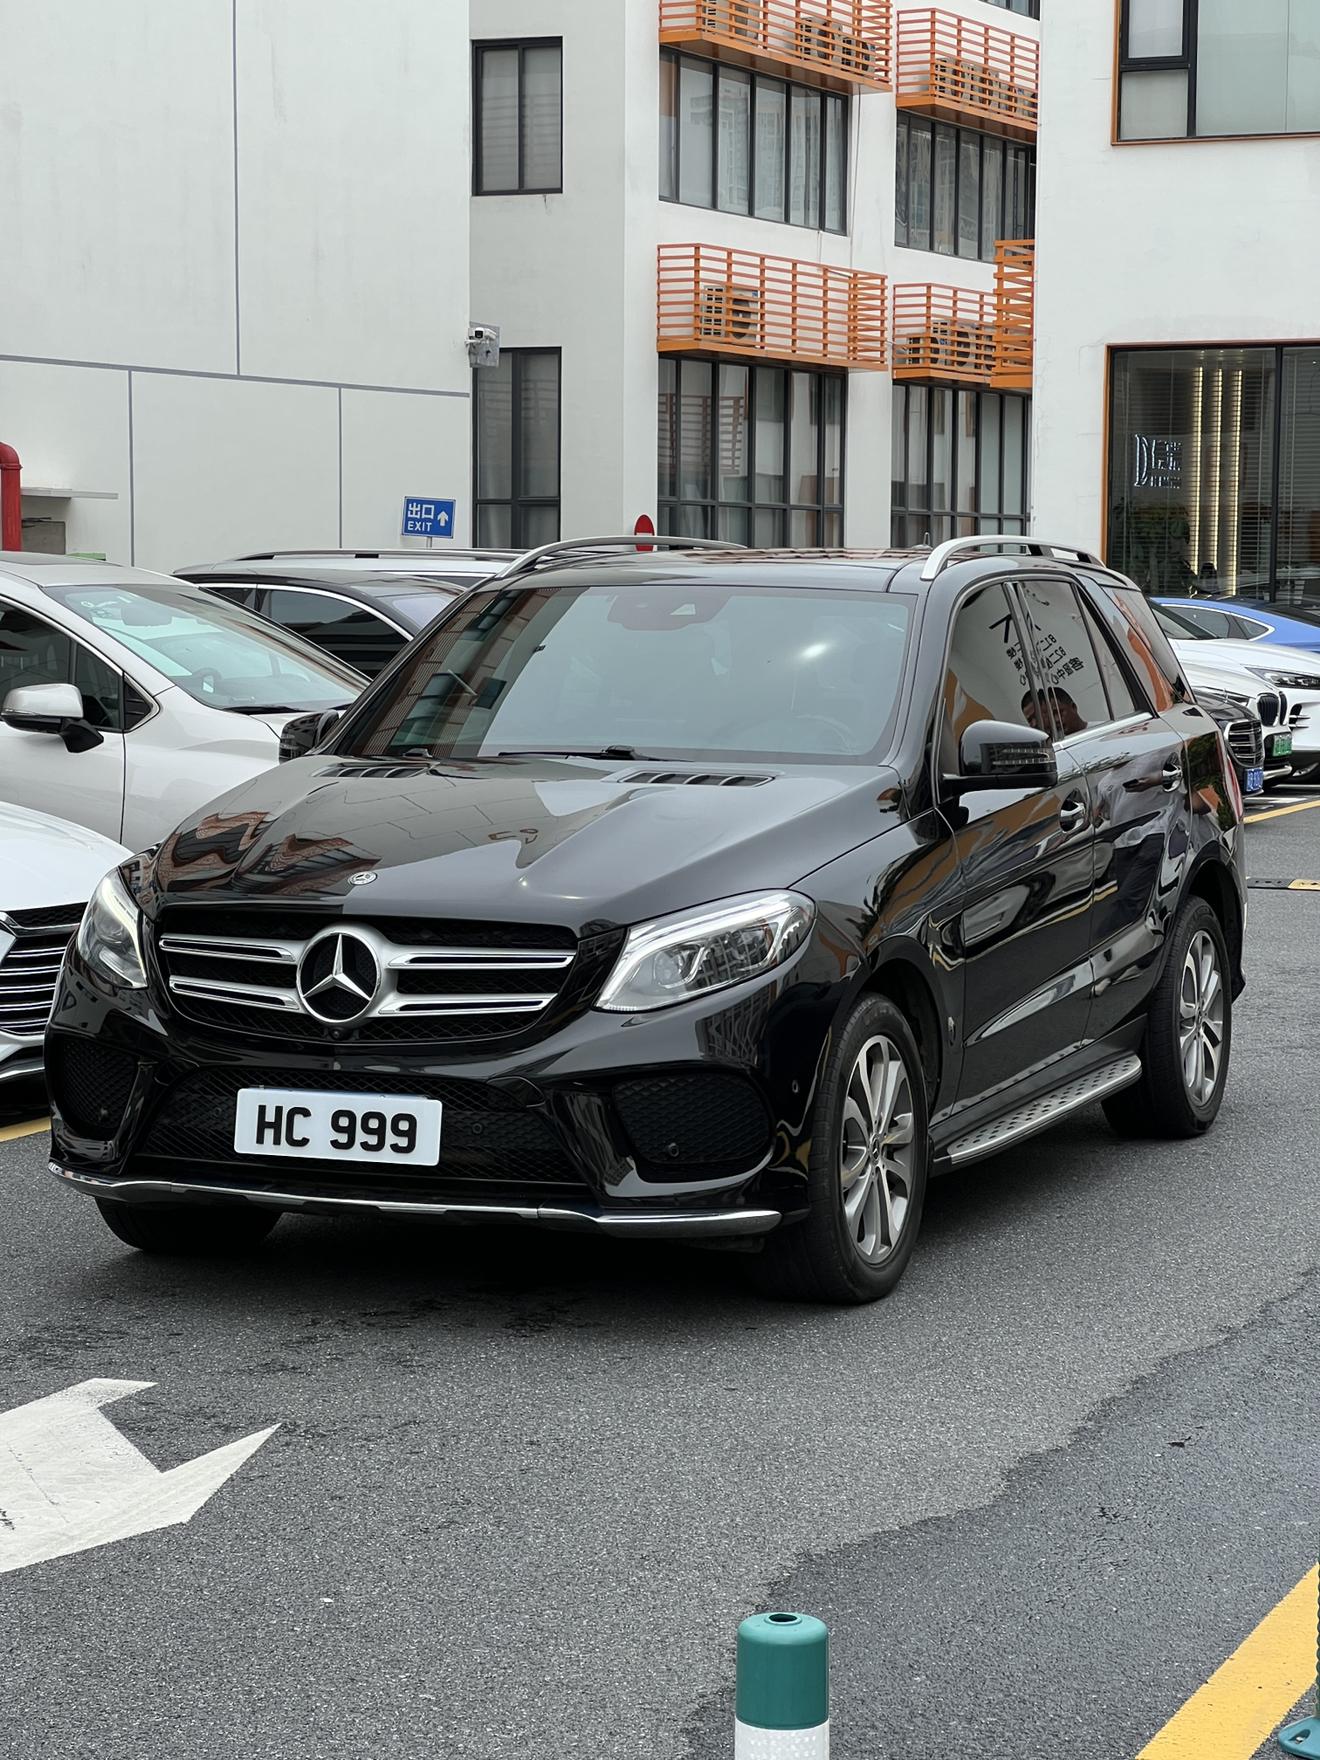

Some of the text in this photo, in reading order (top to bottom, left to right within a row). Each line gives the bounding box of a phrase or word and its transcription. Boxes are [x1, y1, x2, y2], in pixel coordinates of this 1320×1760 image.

[407, 502, 435, 519] 出口
[407, 521, 432, 532] EXIT
[255, 1104, 417, 1154] HC 999
